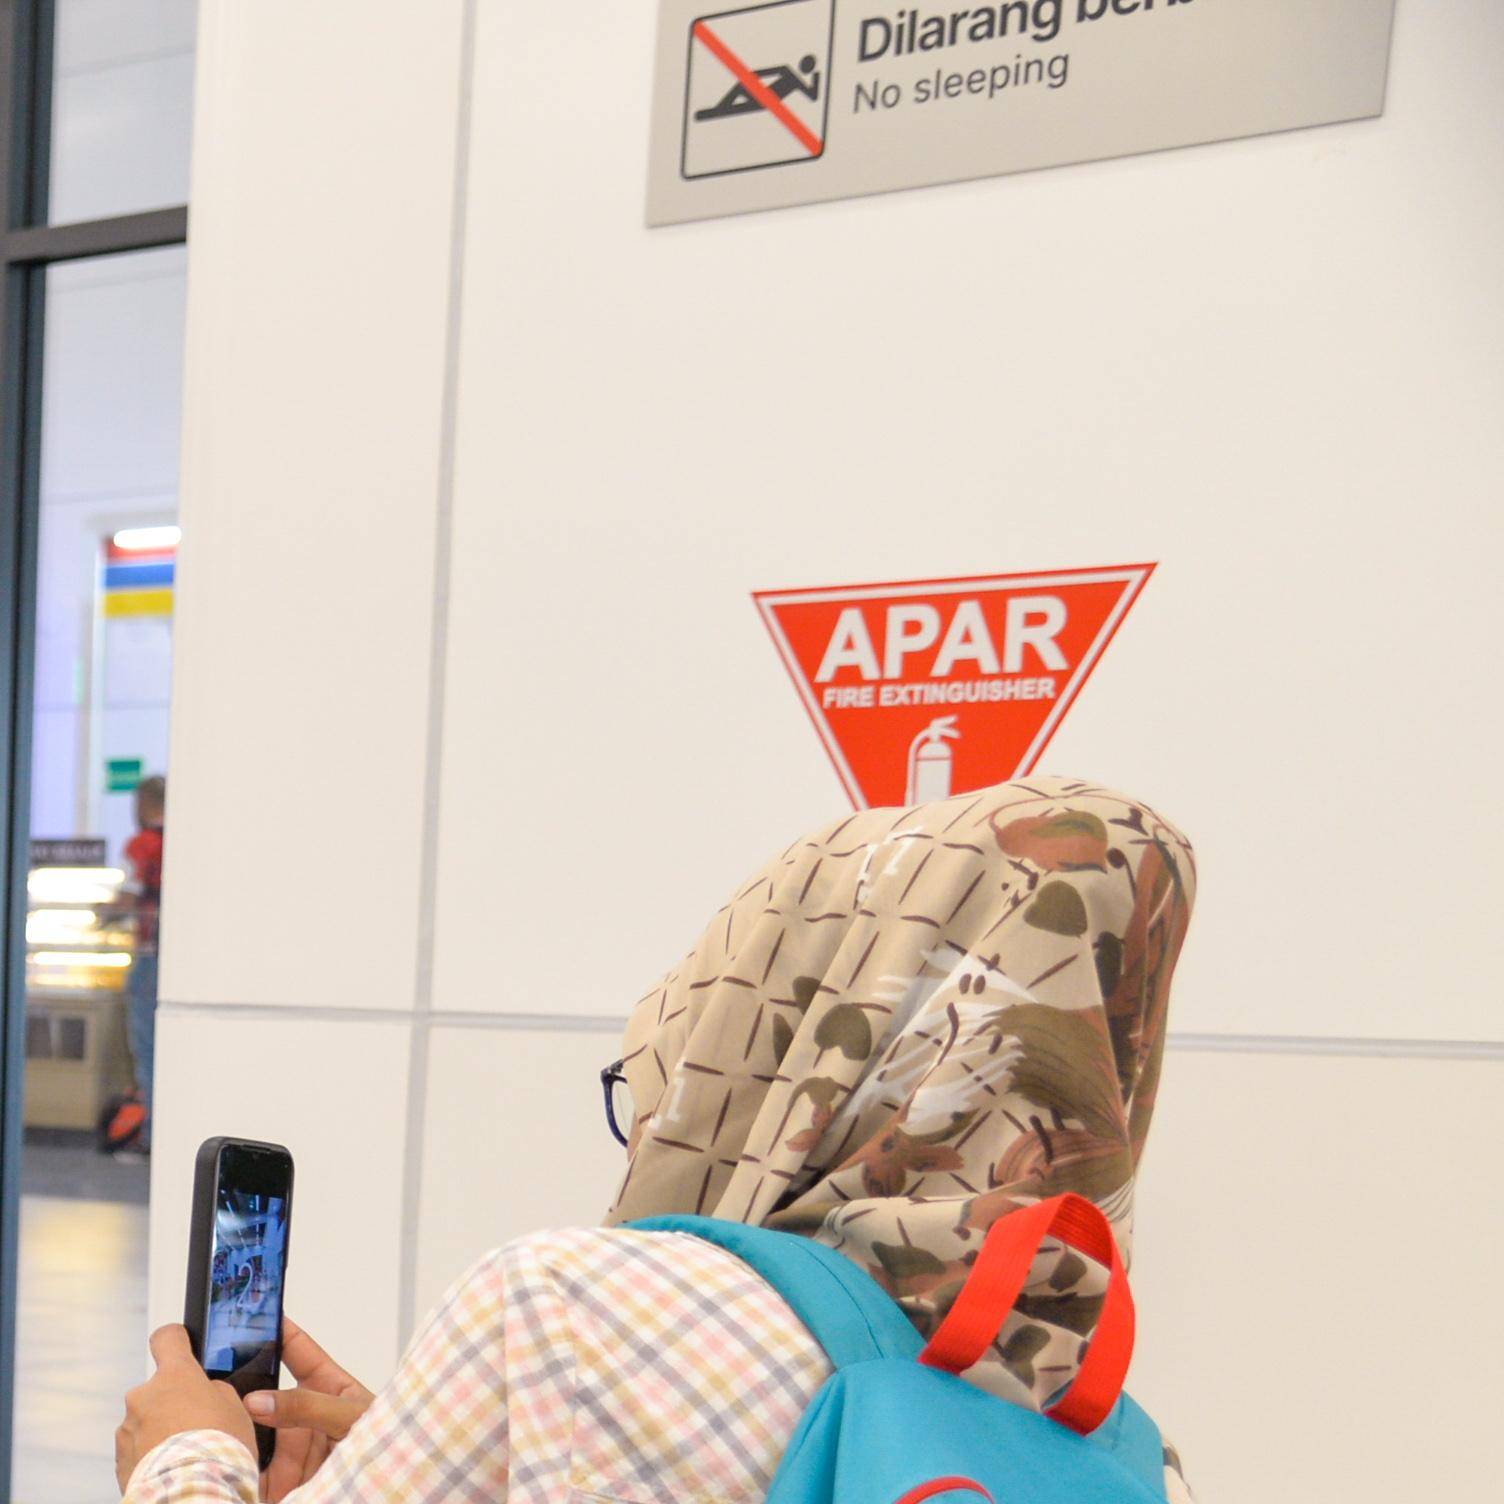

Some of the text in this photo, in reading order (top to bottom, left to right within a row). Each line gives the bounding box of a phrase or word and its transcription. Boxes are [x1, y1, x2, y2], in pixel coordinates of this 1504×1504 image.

[858, 0, 1062, 62] Dilarang
[853, 54, 1069, 114] No sleeping
[814, 595, 1070, 683] APAR
[823, 677, 1056, 709] FIRE EXTINGUISHER
